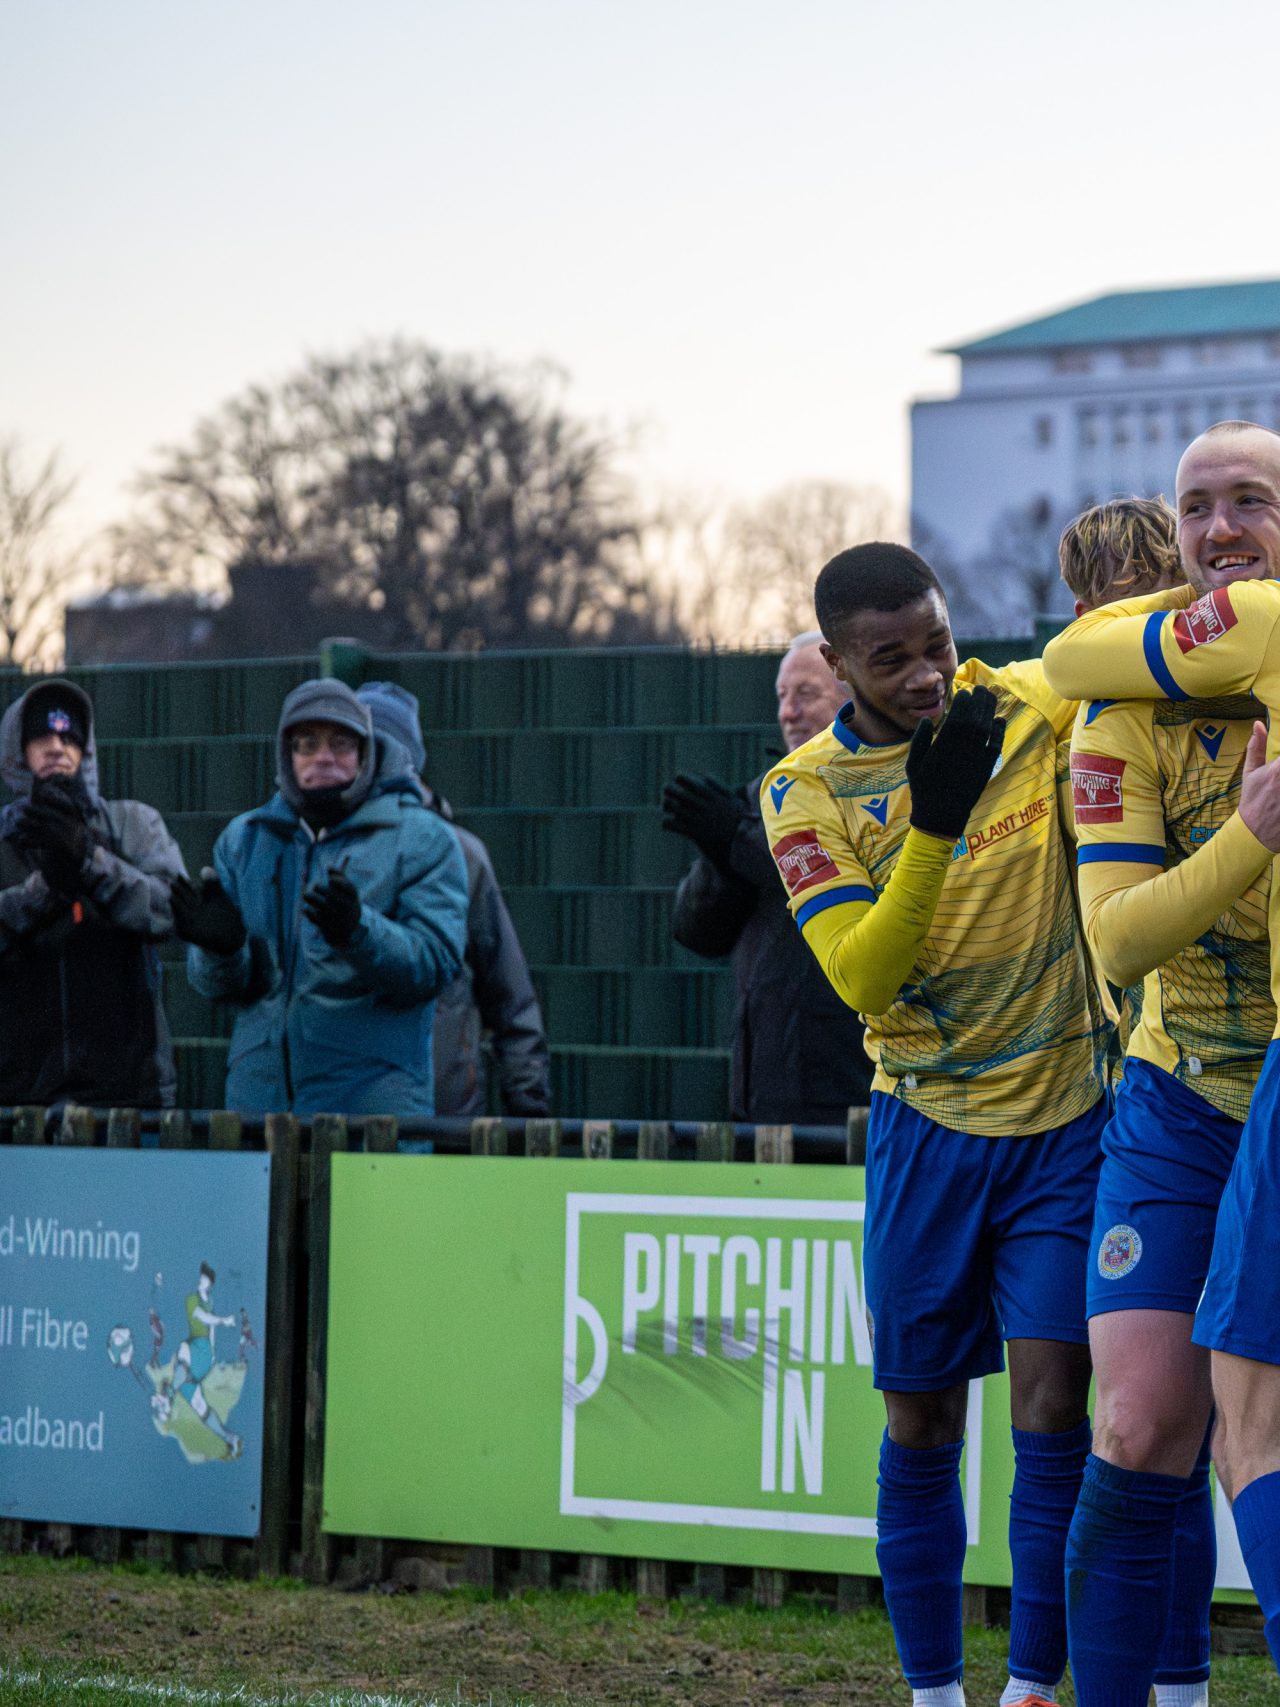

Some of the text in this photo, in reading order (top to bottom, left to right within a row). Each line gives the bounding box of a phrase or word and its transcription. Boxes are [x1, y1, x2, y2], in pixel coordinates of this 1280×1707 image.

[966, 813, 1016, 862] PLANT
[1019, 797, 1049, 824] HIRE
[21, 1306, 89, 1350] Fibre
[622, 1232, 874, 1366] PITCHIN
[0, 1405, 104, 1451] adband
[760, 1367, 826, 1495] IN
